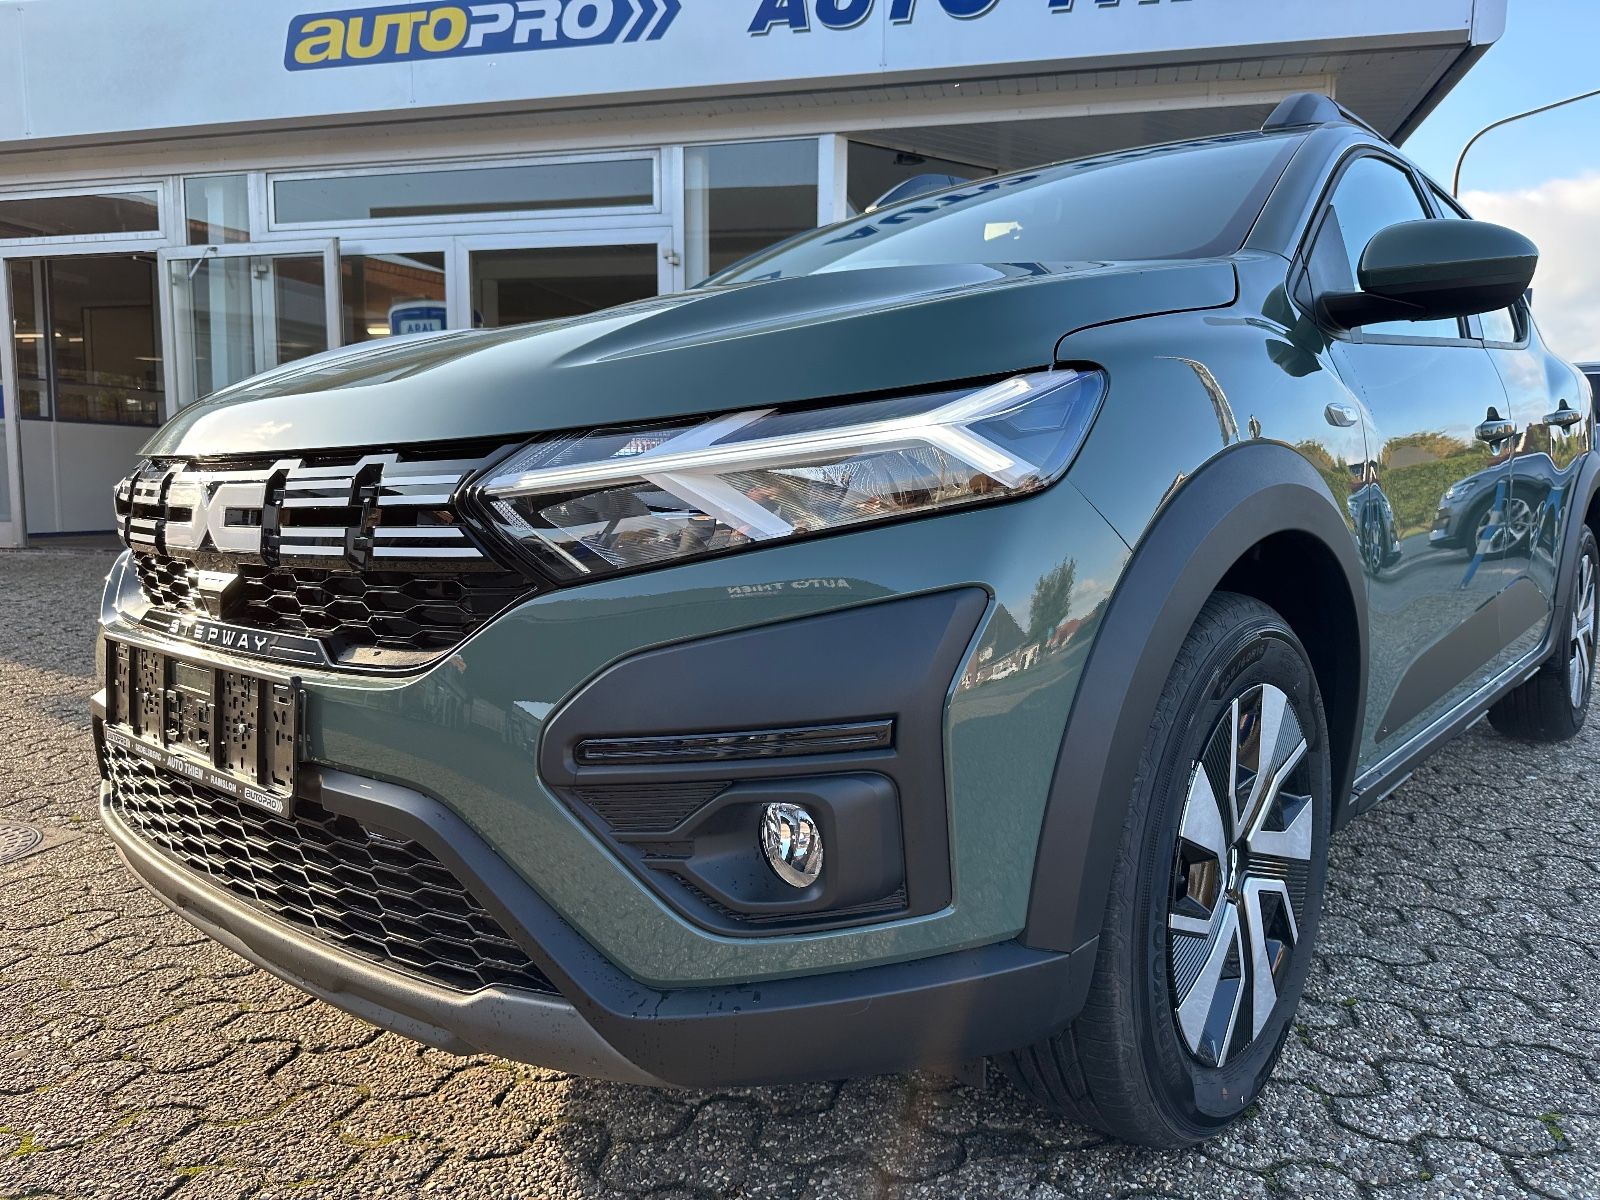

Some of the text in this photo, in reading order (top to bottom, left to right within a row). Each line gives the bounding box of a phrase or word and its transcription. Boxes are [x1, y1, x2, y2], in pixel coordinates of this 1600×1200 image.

[168, 619, 268, 651] STEPWAY
[166, 755, 184, 771] AUTO
[185, 762, 204, 780] THIEN
[210, 775, 237, 793] RAMSLOH
